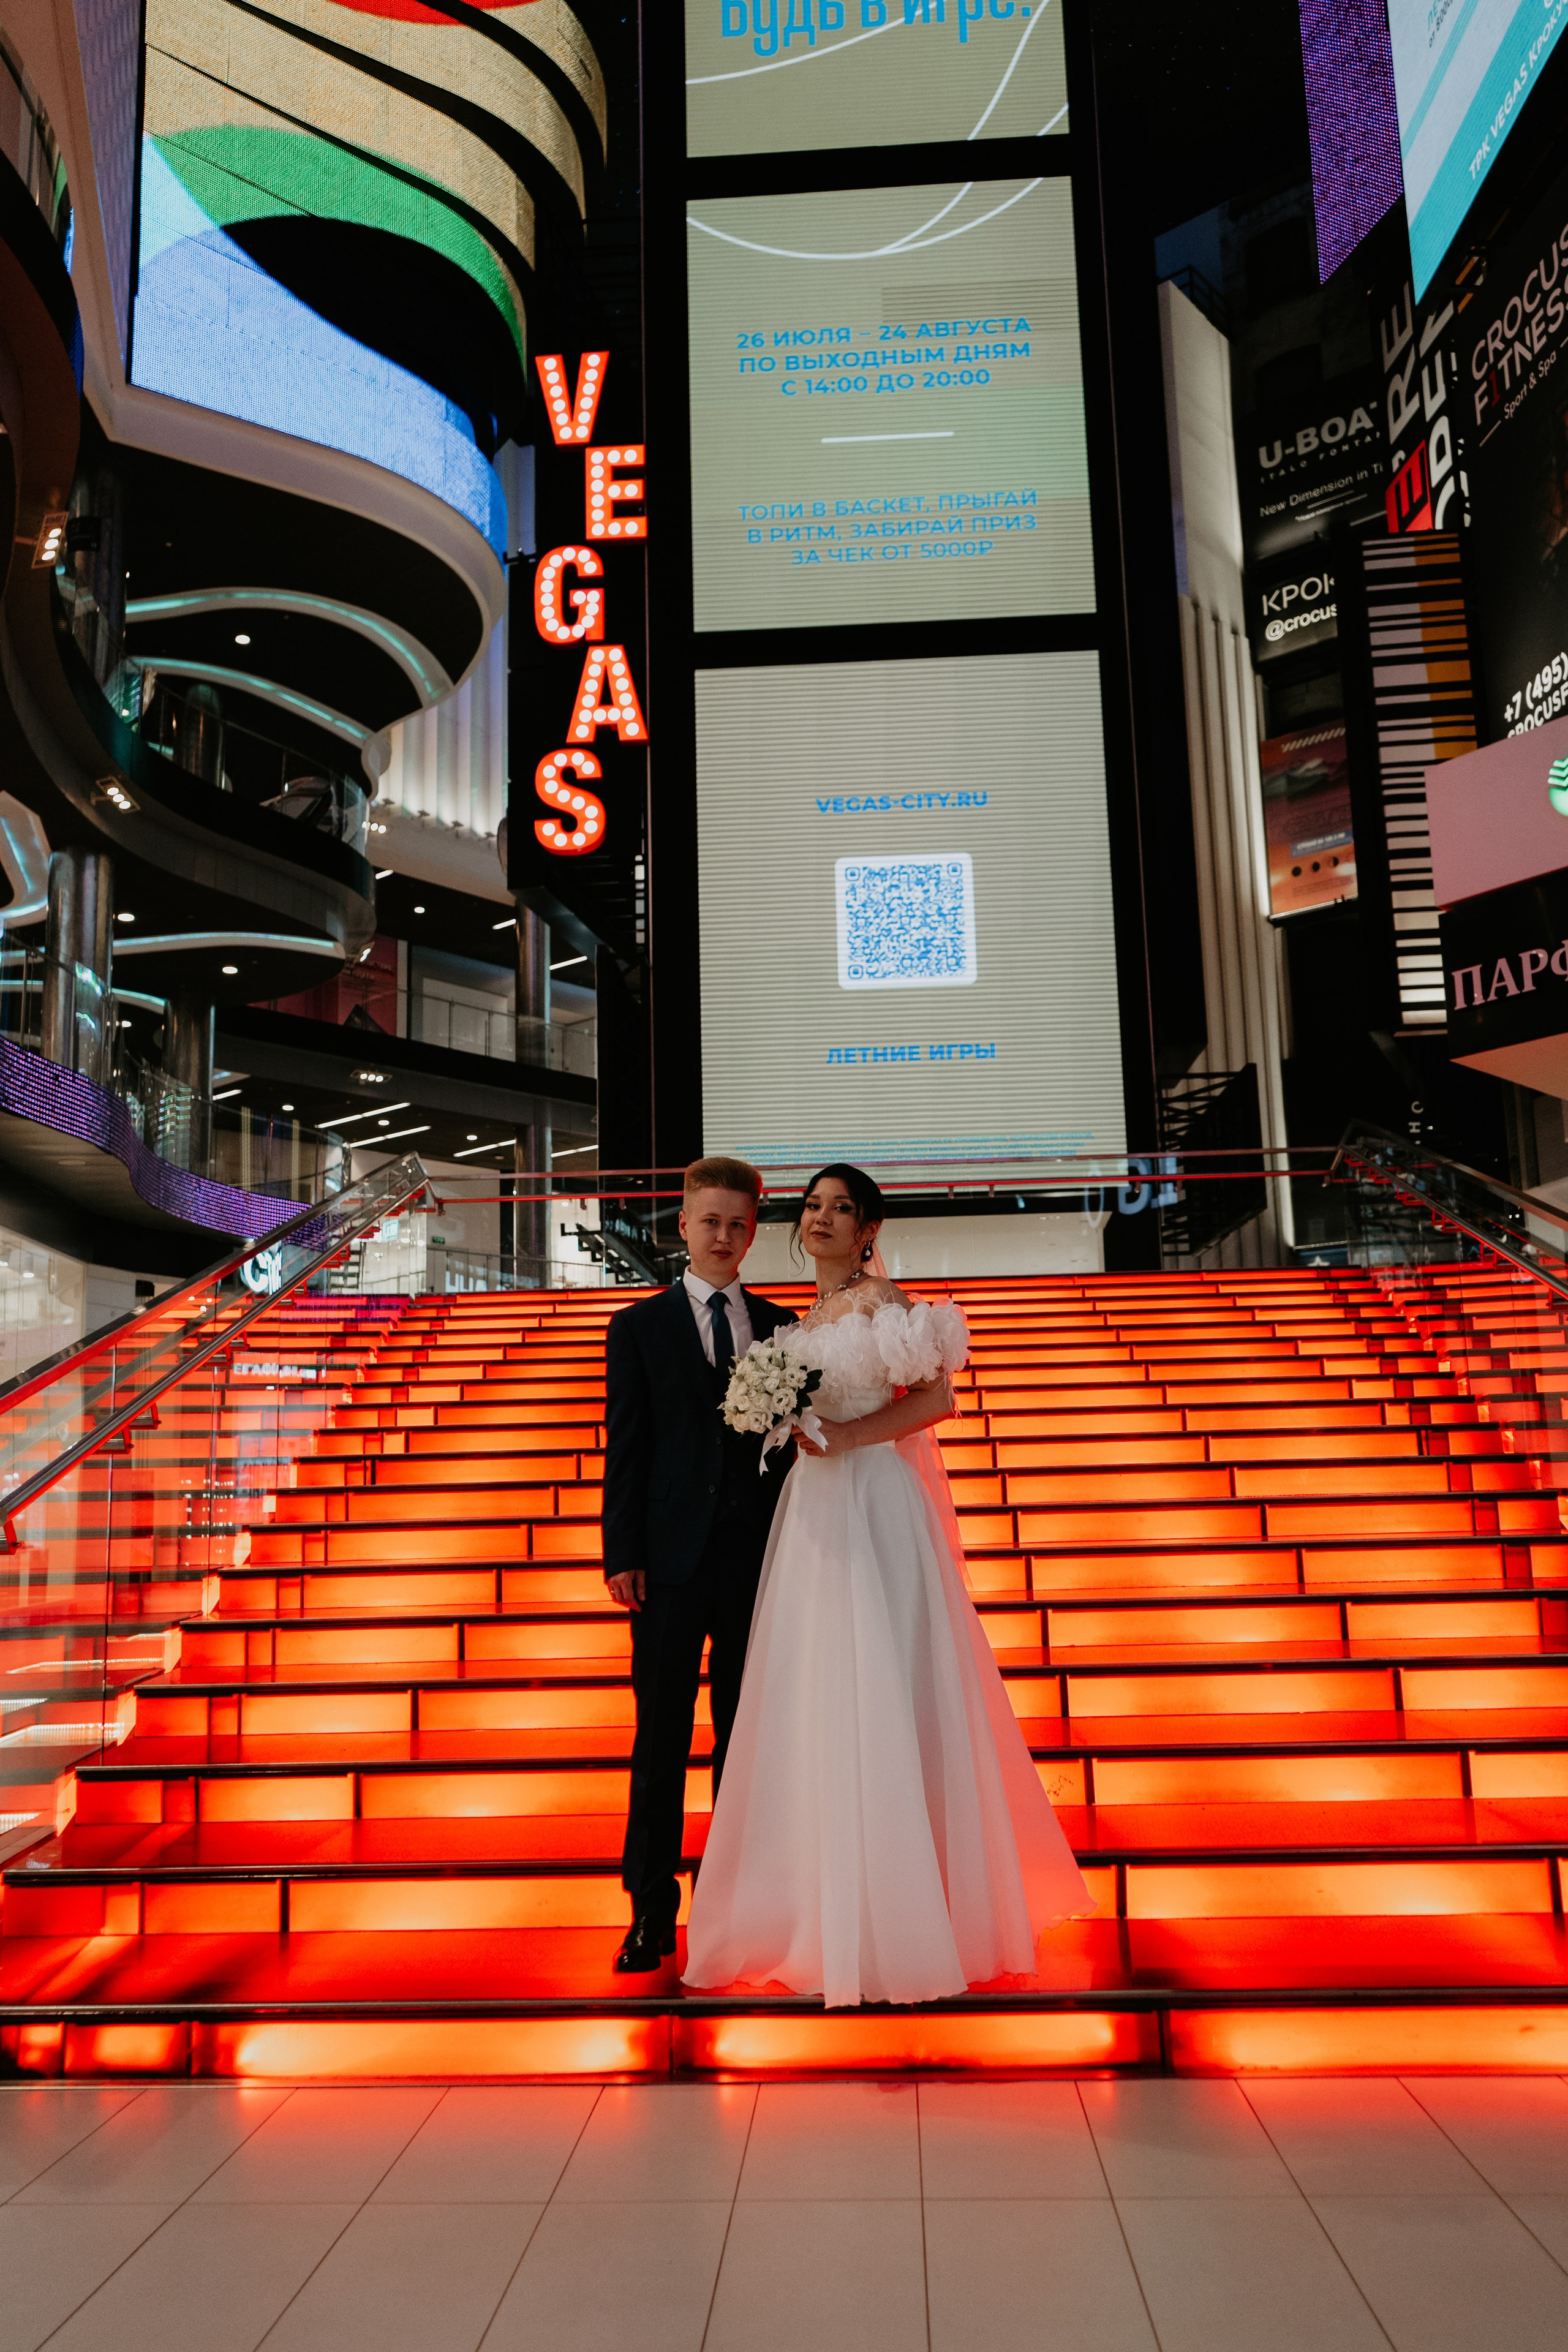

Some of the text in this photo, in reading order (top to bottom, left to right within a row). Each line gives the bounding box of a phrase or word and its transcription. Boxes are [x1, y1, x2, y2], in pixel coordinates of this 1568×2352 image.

[1490, 62, 1528, 138] VEGAS
[736, 333, 766, 349] 26
[774, 326, 851, 347] ИЮЛЯ
[878, 324, 908, 341] 24
[915, 317, 1032, 339] АВГУСТА
[739, 342, 1031, 373] ПО ВЫХОДНЫМ ДНЯМ
[781, 368, 991, 396] С 14:00 ДО 20:00
[1504, 350, 1557, 420] Sport & Spa
[1258, 401, 1378, 469] U-BOA
[737, 487, 1038, 522] ТОПИ В БАСКЕТ, ПРЫГАЙ
[1259, 500, 1287, 517] New
[1289, 475, 1354, 507] Dimension
[1357, 469, 1369, 481] in
[747, 513, 1038, 544] В РИТМ, ЗАБИРАЙ ПРИЗ
[791, 549, 822, 566] ЗА
[828, 546, 875, 564] ЧЕК
[881, 544, 913, 562] ОТ
[535, 351, 649, 856] VEGAS
[1504, 652, 1568, 723] +7 (495)
[815, 791, 988, 815] VEGAS-CITY.RU
[826, 1042, 997, 1064] ЛЕТНИЕ ИГРЫ
